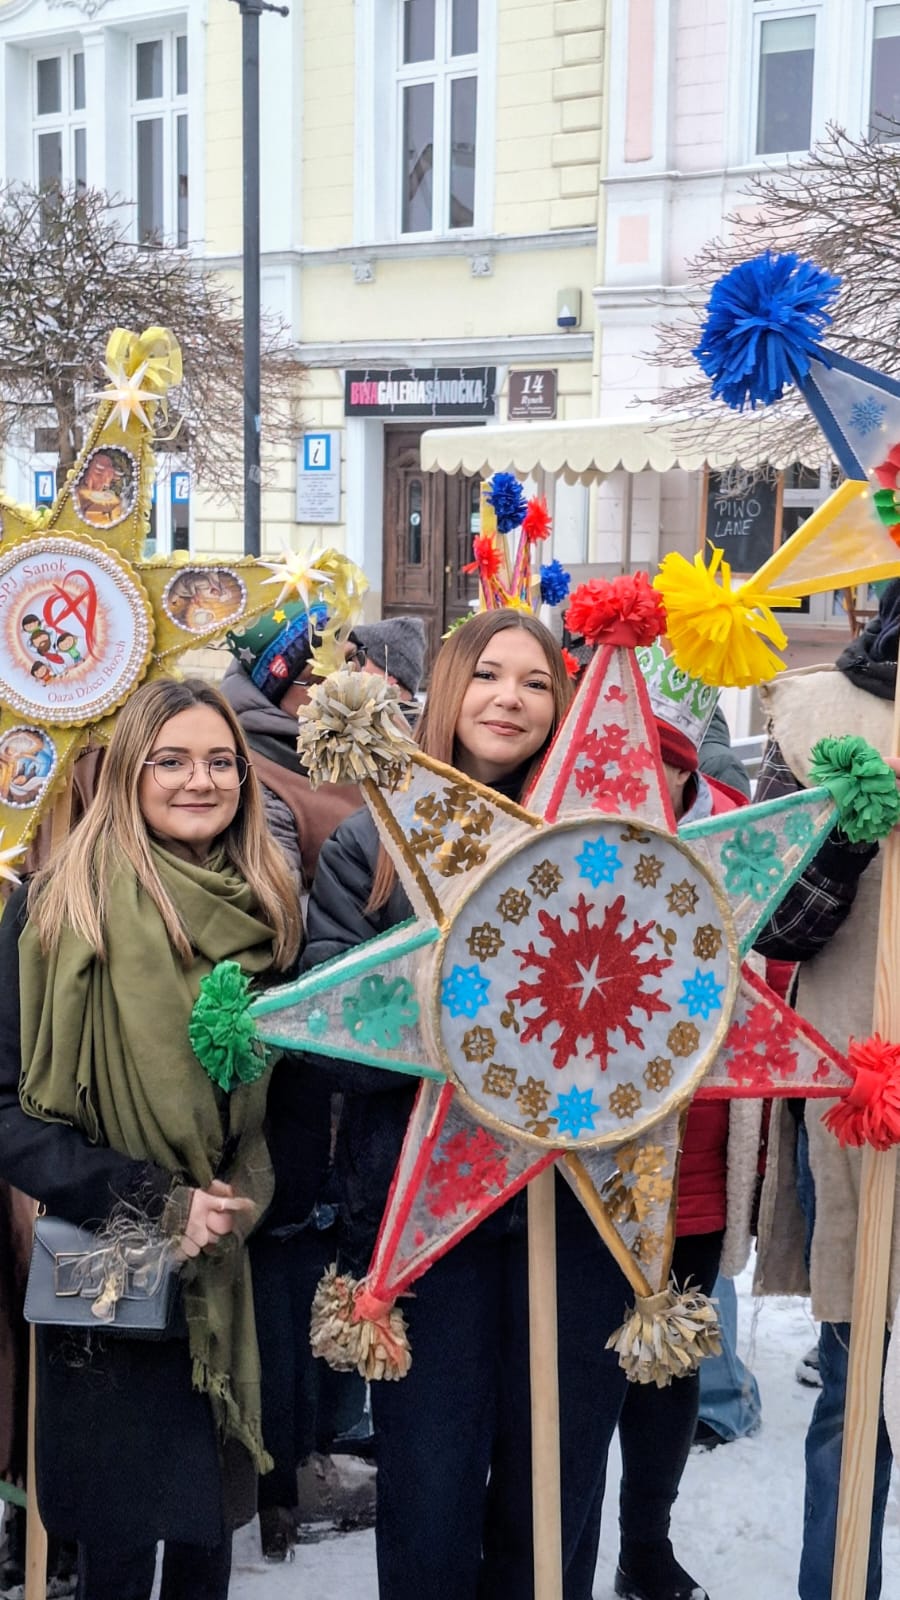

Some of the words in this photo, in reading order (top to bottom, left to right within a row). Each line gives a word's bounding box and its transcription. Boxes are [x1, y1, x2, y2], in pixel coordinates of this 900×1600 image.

[521, 375, 544, 394] 14
[714, 499, 761, 518] PIWO
[714, 520, 754, 538] LANE
[0, 576, 17, 607] SPJ
[23, 558, 66, 578] Sanok
[48, 692, 74, 702] Oaza
